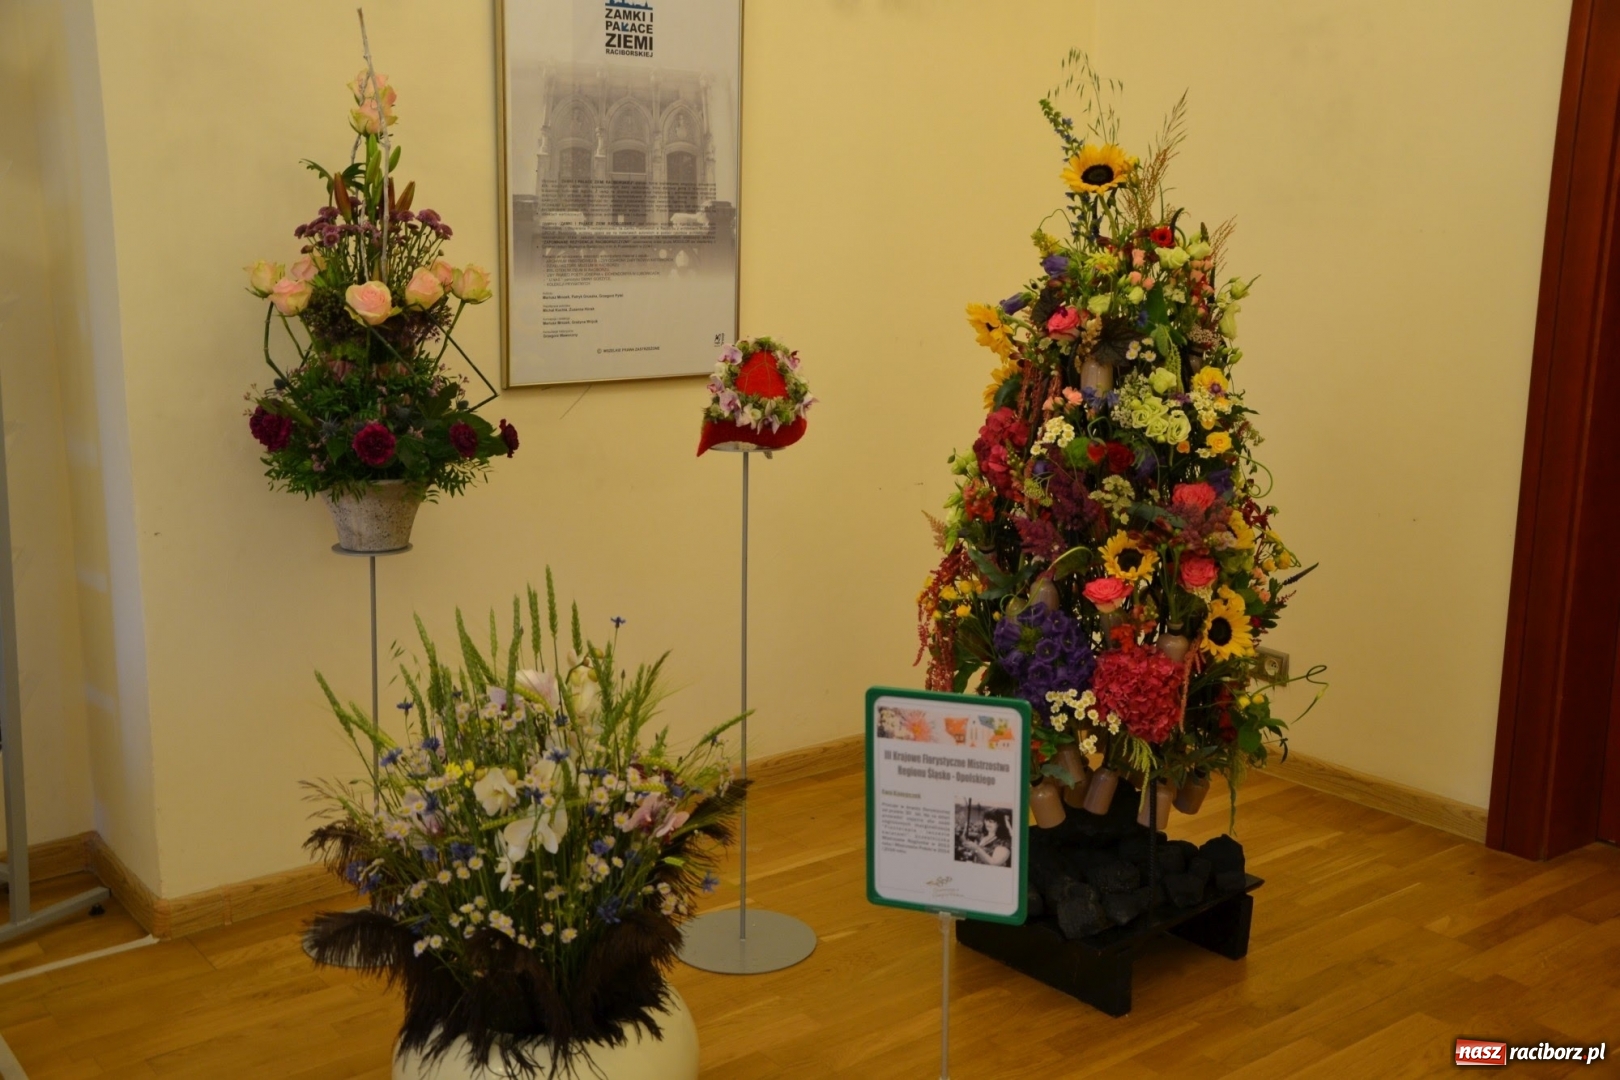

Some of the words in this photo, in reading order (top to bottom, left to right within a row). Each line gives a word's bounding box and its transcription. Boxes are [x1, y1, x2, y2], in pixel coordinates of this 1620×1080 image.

[605, 8, 646, 22] ZAMKI
[650, 12, 654, 23] I
[605, 32, 653, 51] ZIEMI
[605, 48, 654, 58] RACIBORSKIEJ
[892, 750, 922, 764] Krajowe
[922, 753, 966, 768] Florystyczne
[967, 758, 1010, 773] Mistrzostwa
[897, 765, 927, 778] Regionu
[927, 767, 951, 781] Śląsko
[956, 771, 996, 786] Opolskiego
